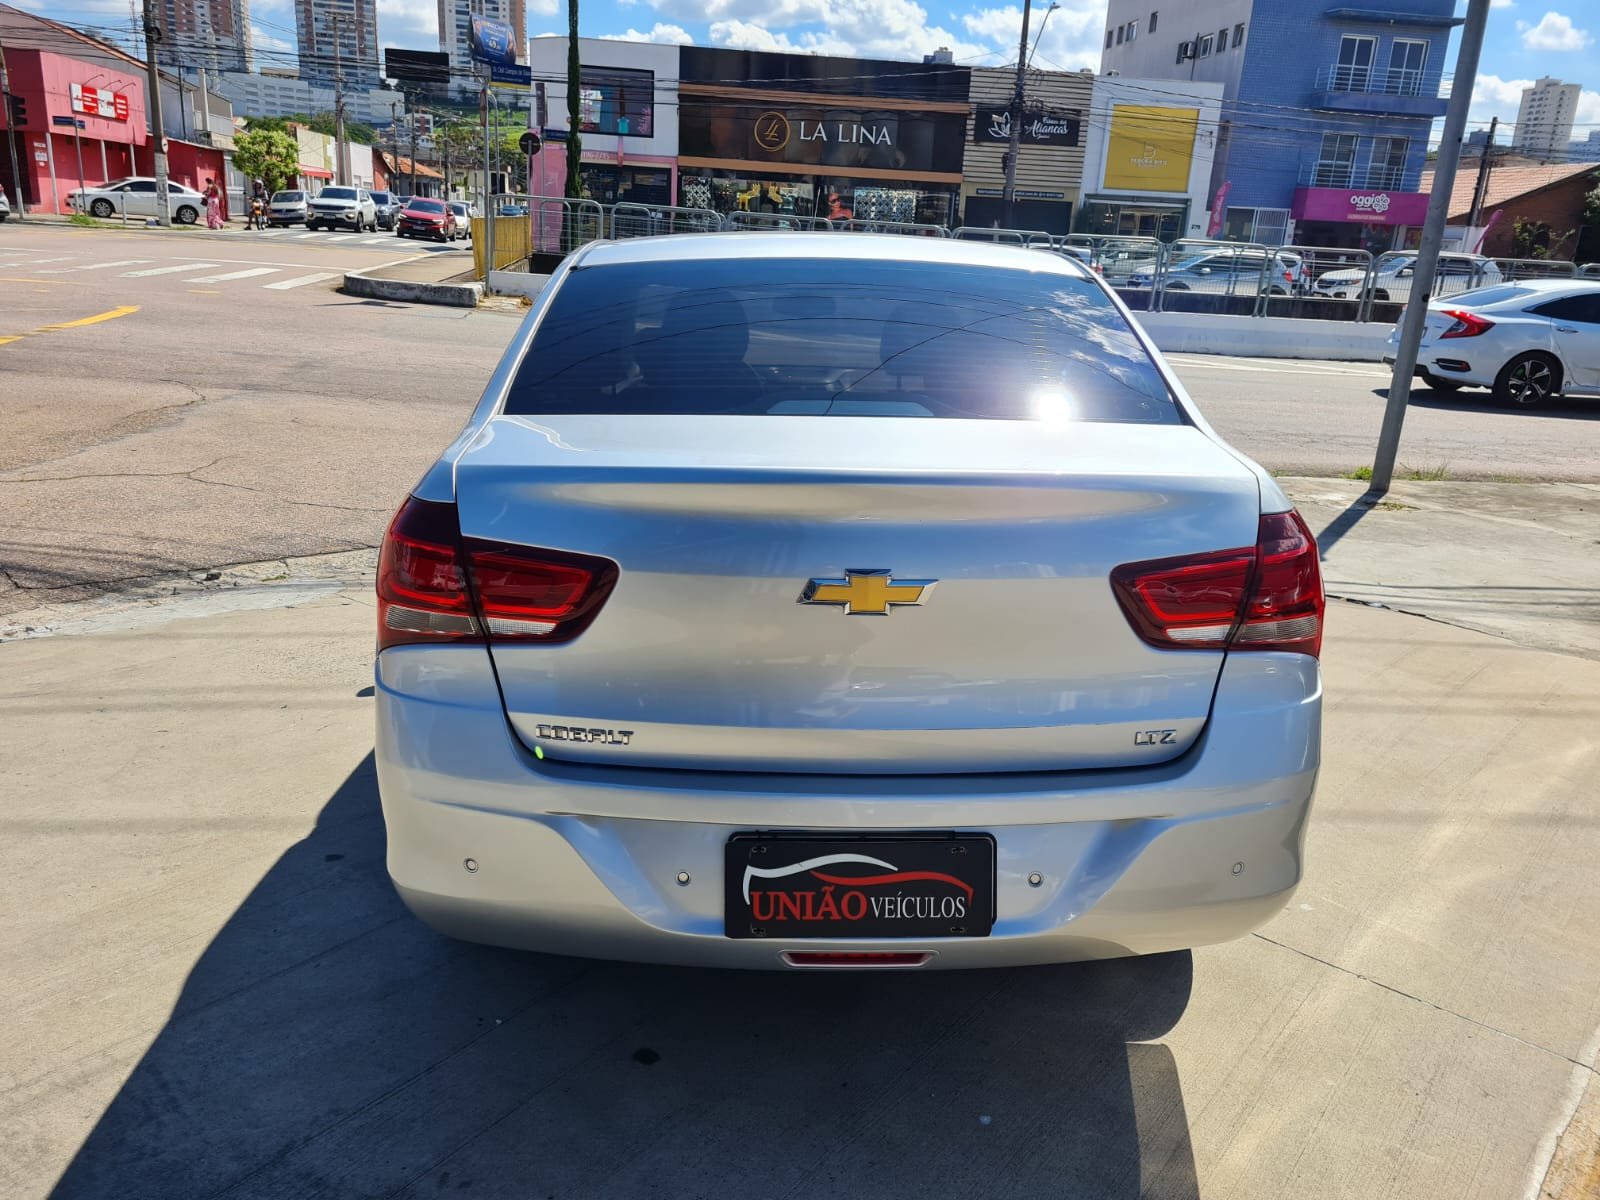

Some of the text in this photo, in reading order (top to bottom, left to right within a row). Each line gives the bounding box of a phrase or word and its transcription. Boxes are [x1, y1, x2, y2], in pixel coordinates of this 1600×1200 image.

[799, 120, 892, 146] LA LINA
[1350, 193, 1375, 207] oggi
[535, 724, 634, 745] COBALT
[1135, 729, 1177, 746] LTZ
[750, 885, 966, 921] UNIÃO VEÍCULOS
